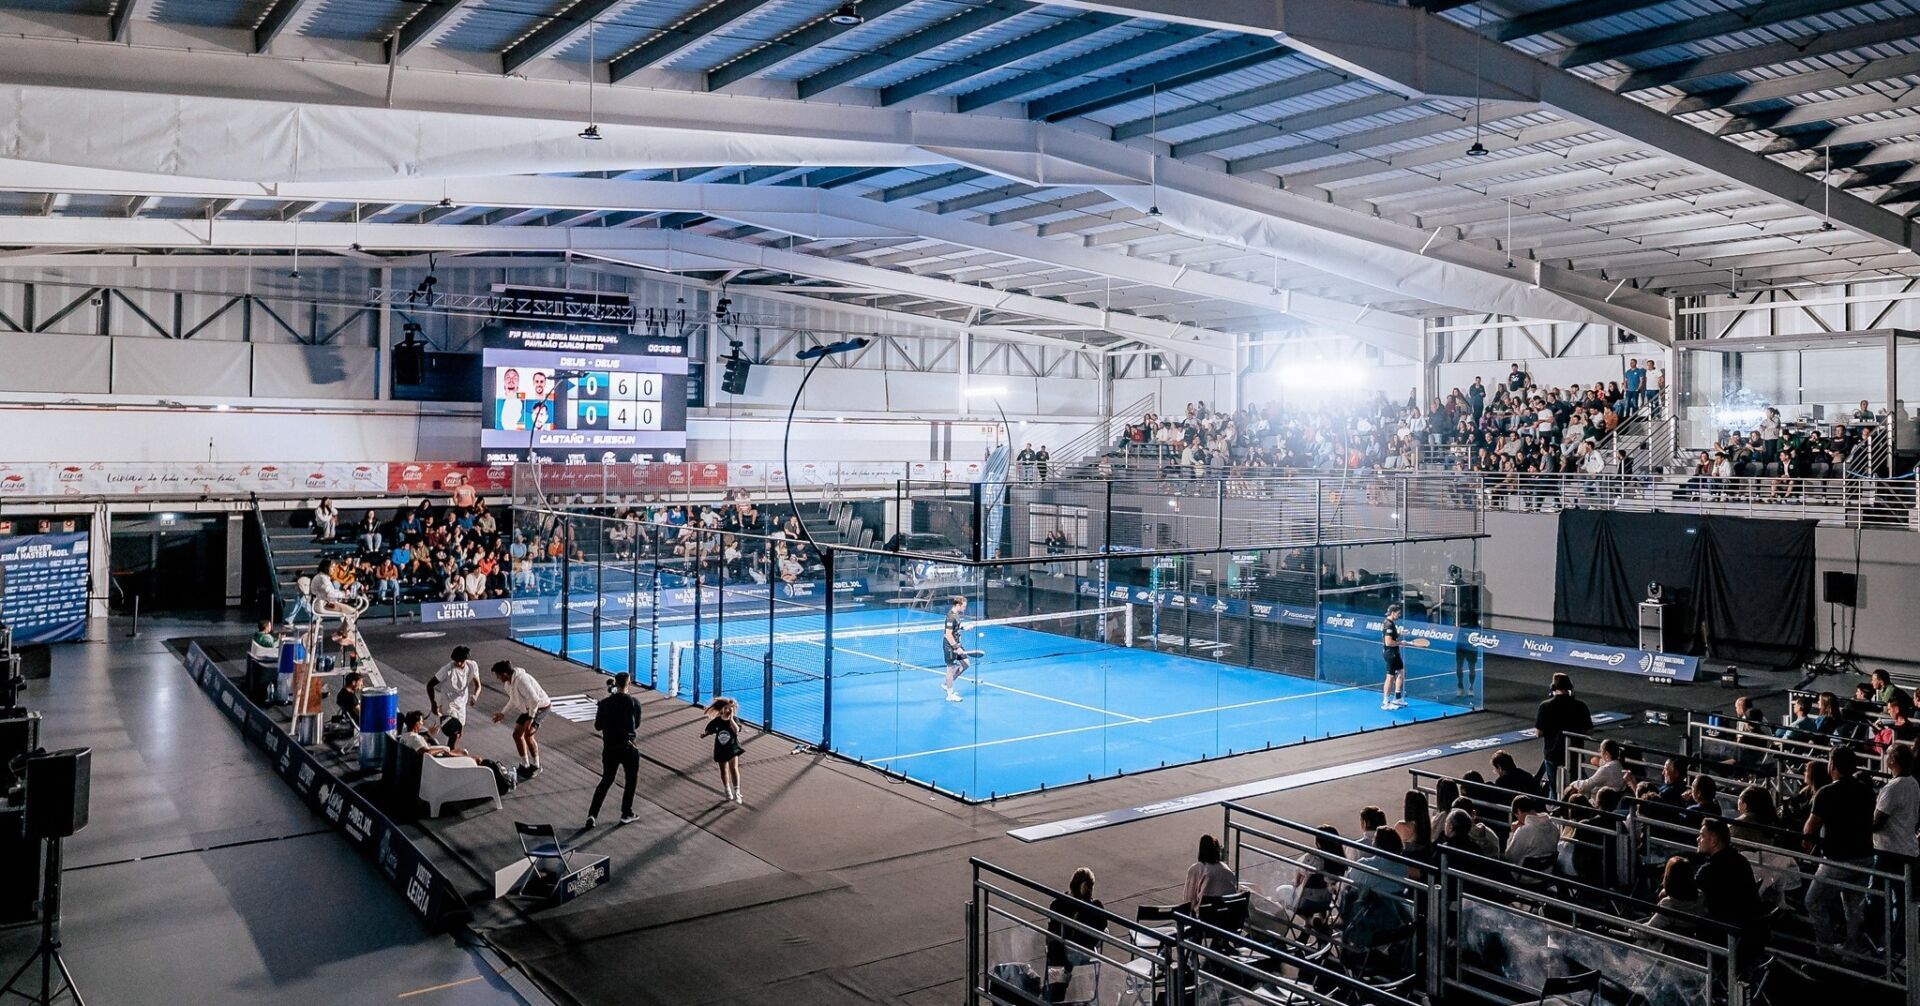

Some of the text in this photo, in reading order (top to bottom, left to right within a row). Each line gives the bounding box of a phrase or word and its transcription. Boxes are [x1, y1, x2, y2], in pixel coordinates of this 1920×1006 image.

[547, 333, 568, 341] LEIRIA
[569, 334, 597, 342] MASTER
[597, 335, 618, 343] PADEL
[559, 341, 585, 350] CARLOS
[586, 342, 604, 350] NETO
[560, 357, 586, 367] DEUS
[594, 359, 620, 369] DEUS
[586, 377, 653, 396] 0 6 0
[586, 406, 652, 425] 0 4 0
[540, 433, 584, 444] CASTAÑO
[593, 435, 636, 445] SUESCUN
[0, 549, 69, 561] EIRIA MASTER PADEL
[16, 544, 52, 554] FIP SILVER
[437, 609, 476, 619] LEIRIA
[1468, 632, 1499, 648] Carlsberg
[1522, 639, 1553, 653] Nicola
[1569, 650, 1610, 661] Bullpadel
[1654, 655, 1685, 665] INTERNATIONAL
[1652, 667, 1676, 675] FEDERATION
[416, 862, 432, 889] VISITE
[407, 876, 430, 916] LEIRIA
